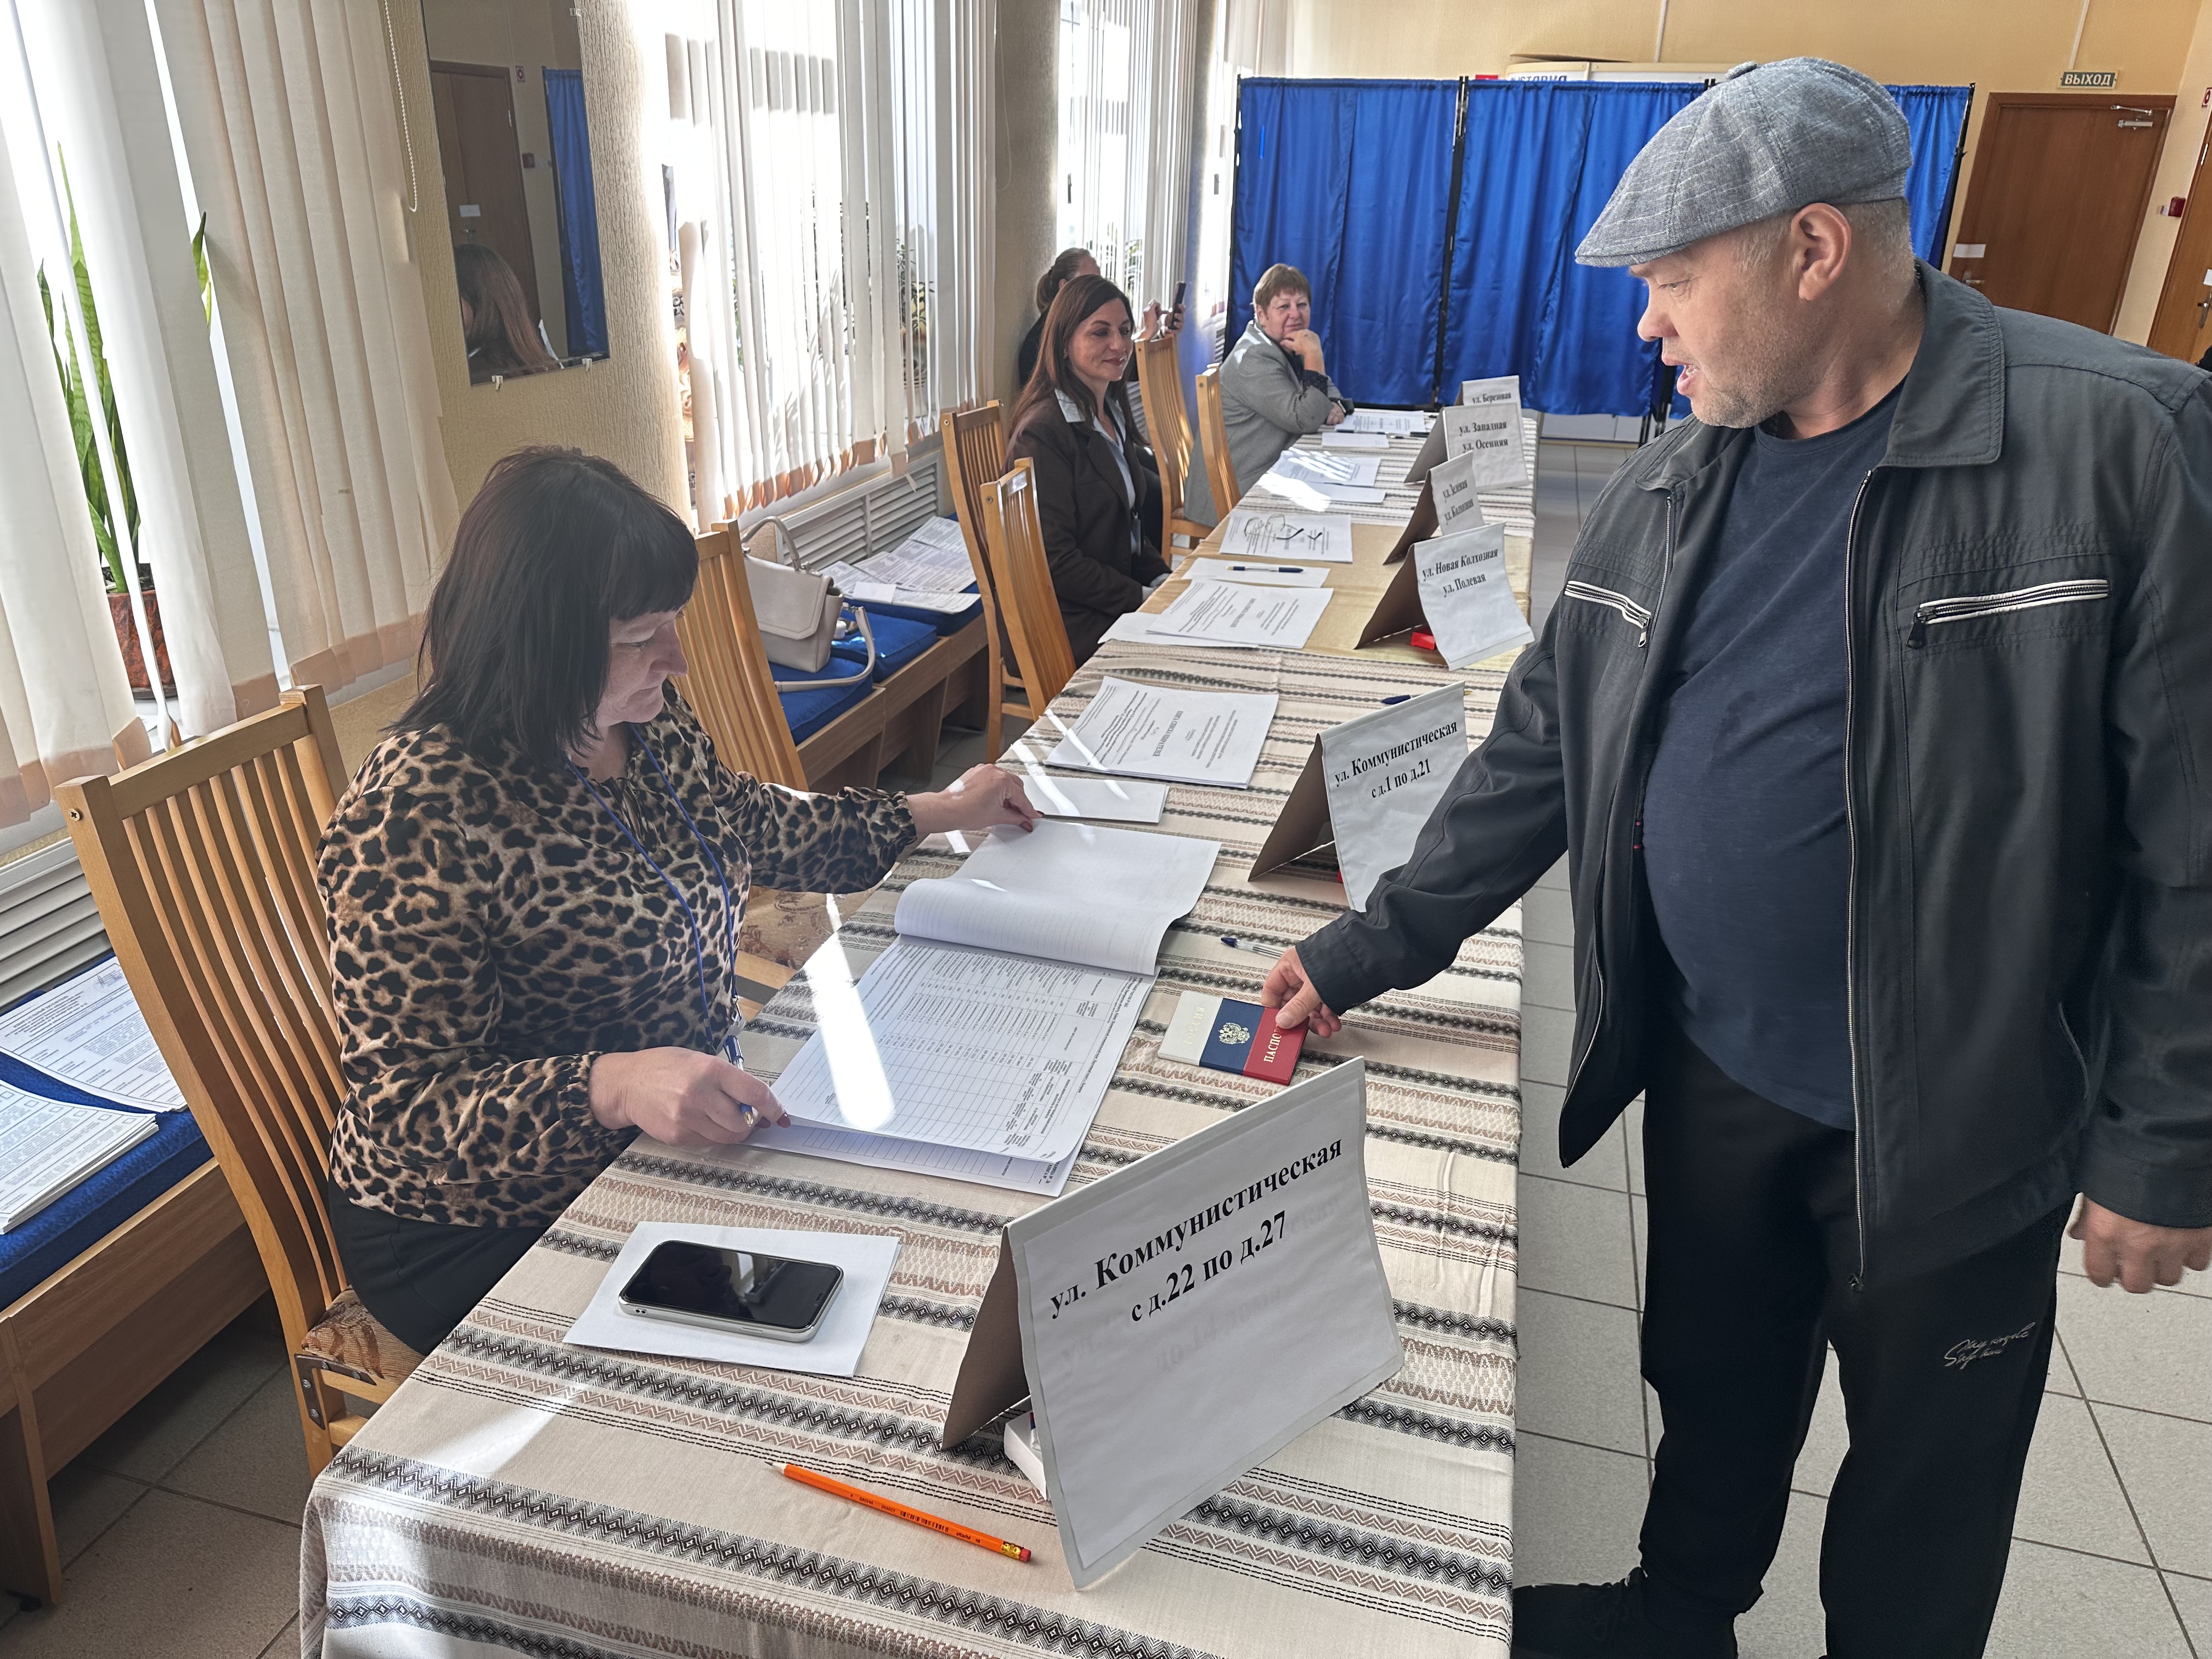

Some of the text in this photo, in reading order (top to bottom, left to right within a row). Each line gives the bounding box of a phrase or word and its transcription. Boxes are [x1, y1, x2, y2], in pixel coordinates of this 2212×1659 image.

[2064, 74, 2112, 86] ВЫХОД
[1482, 392, 1511, 404] Березовая
[1459, 421, 1507, 437] ул. Западная
[1463, 439, 1509, 453] ул. Осенняя
[1422, 549, 1498, 582] ул. Новая Колхозная
[1442, 573, 1487, 598] ул. Полевая
[1334, 721, 1458, 787] ул. Коммунистическая
[1372, 758, 1431, 798] с д.1 по д.21
[1050, 1139, 1342, 1321] ул. Коммунистическая
[1131, 1210, 1286, 1322] с д.22 по д.27
